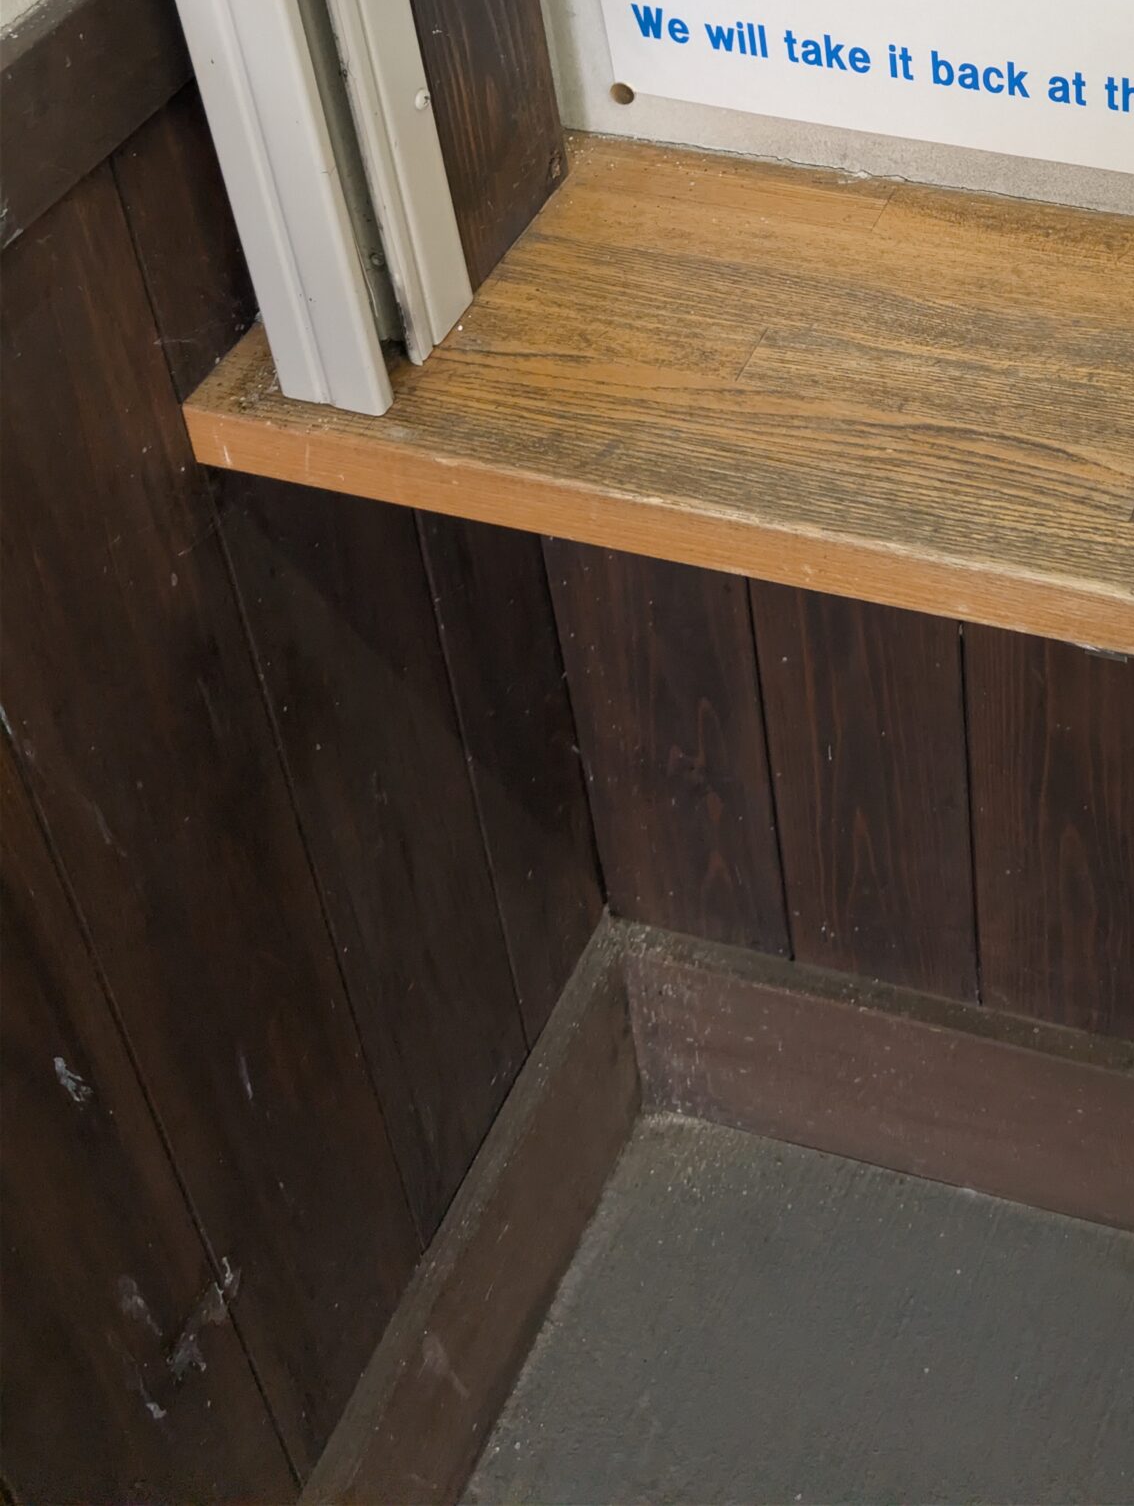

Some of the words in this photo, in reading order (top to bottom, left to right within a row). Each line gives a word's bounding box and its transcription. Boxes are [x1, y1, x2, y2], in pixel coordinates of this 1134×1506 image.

[631, 2, 690, 45] We
[704, 21, 769, 59] will
[783, 29, 872, 74] take
[888, 44, 913, 82] it
[930, 50, 1030, 99] back
[1047, 71, 1087, 107] at
